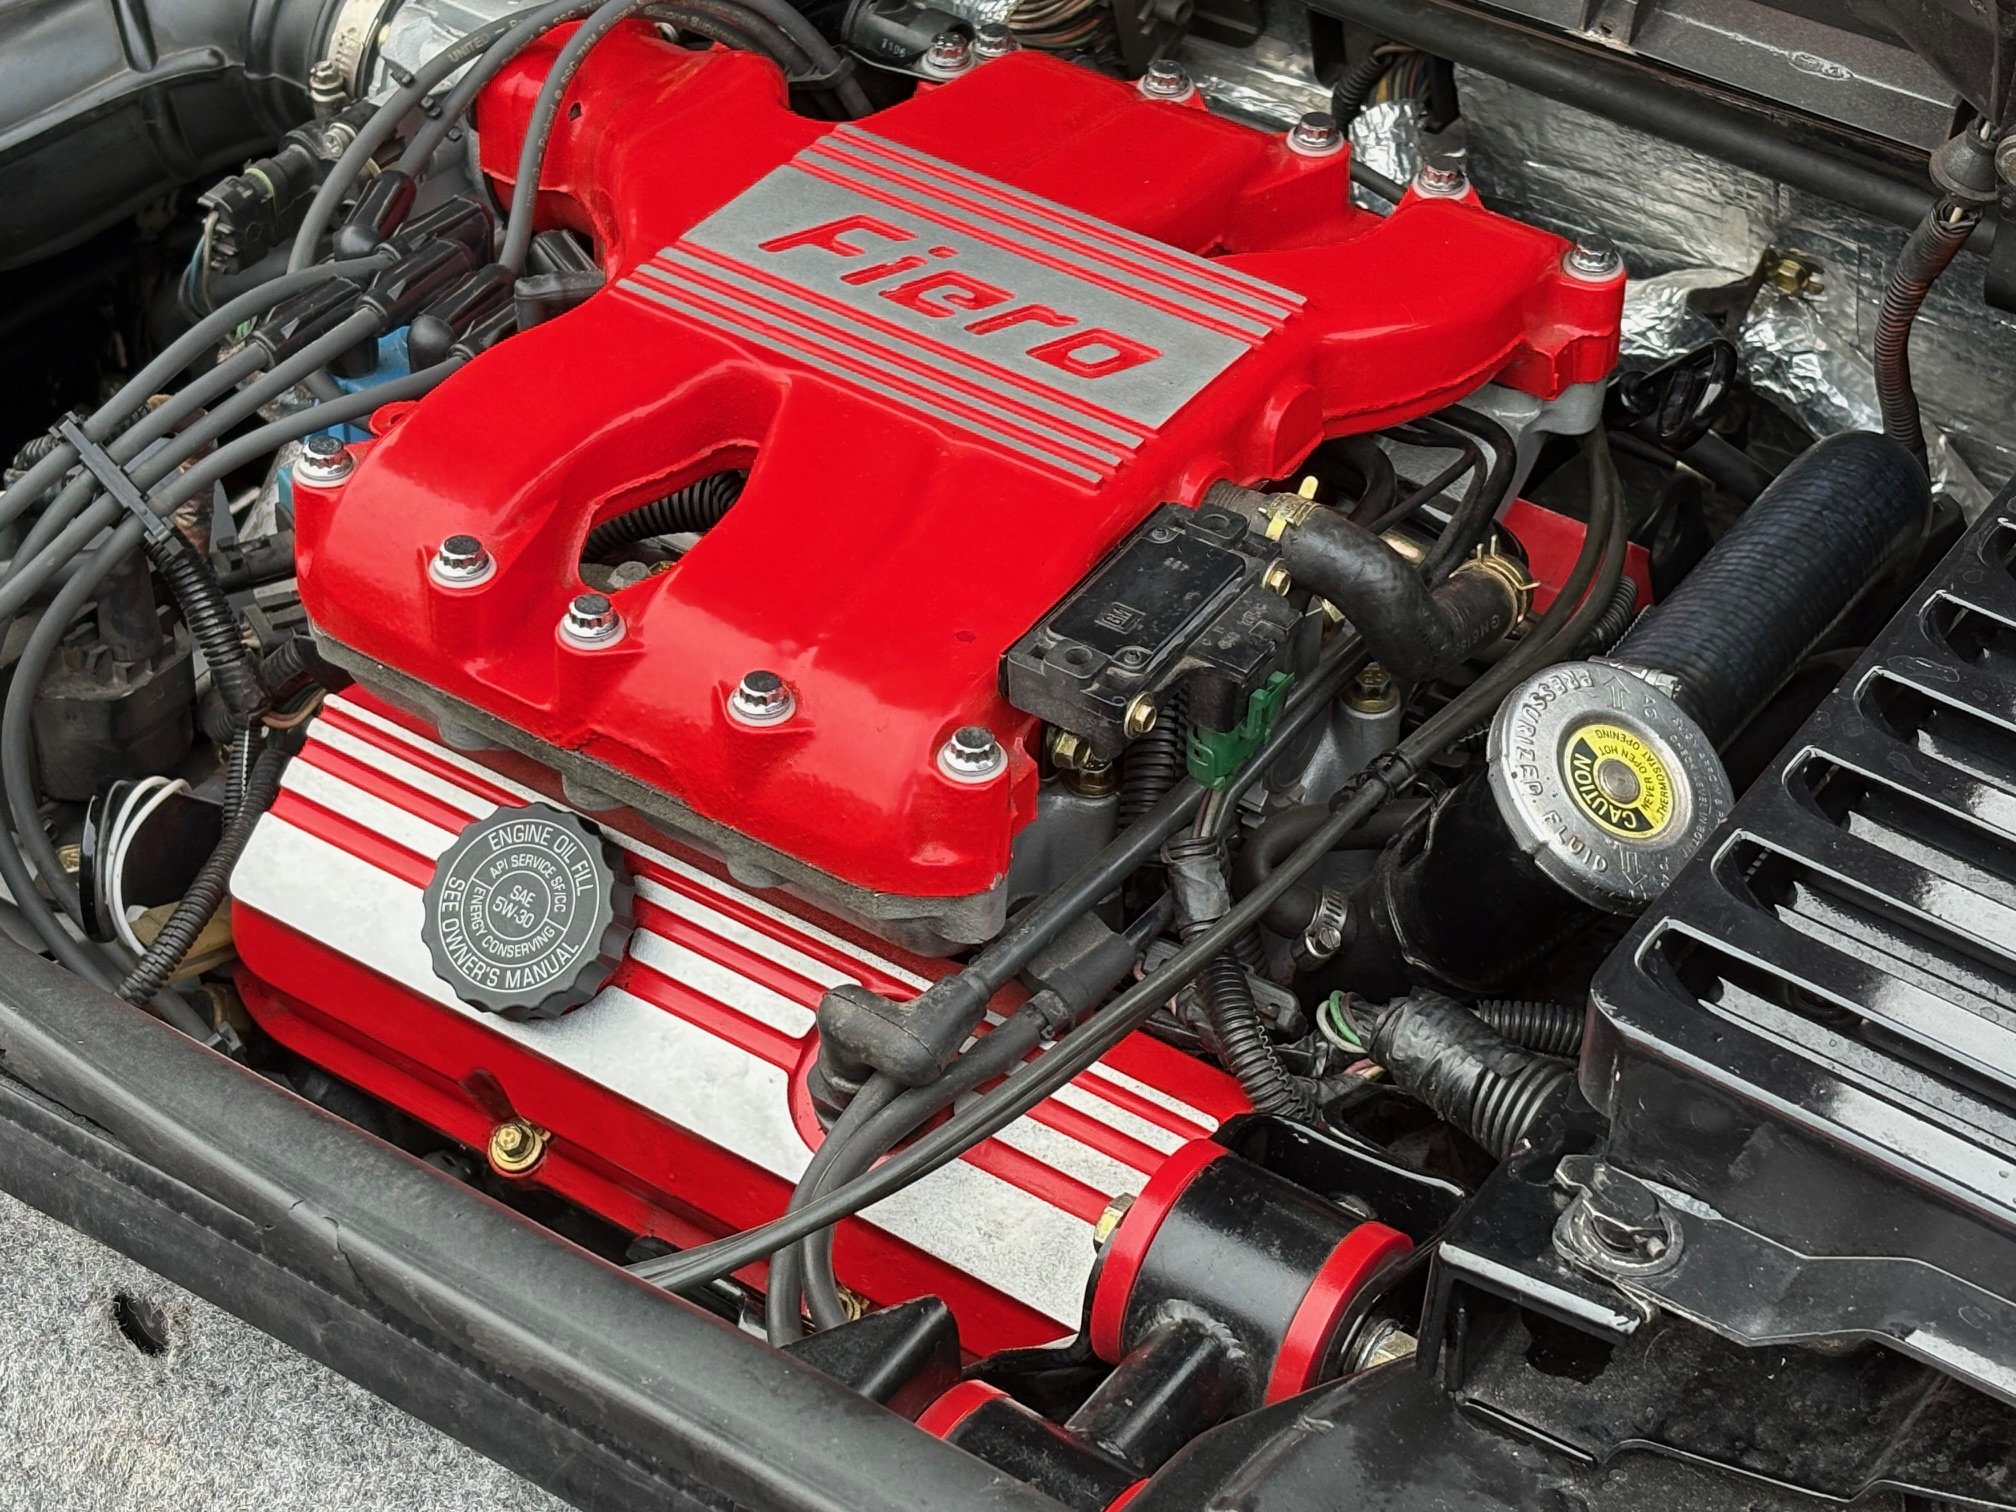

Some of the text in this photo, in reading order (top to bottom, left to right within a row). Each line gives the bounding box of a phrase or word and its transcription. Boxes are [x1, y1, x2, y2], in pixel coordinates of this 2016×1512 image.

[448, 32, 490, 62] UNITED
[758, 214, 1164, 379] Fiero
[1516, 669, 1609, 874] PRESSURIZED FLUID
[1572, 753, 1637, 829] CAUTION
[1596, 729, 1668, 822] THERMOSTAT OPENING
[1598, 745, 1656, 812] NEVER OPEN HOT
[488, 824, 594, 897] ENGINE OIL FILL
[489, 853, 567, 913] API SERVICE SF/CC
[509, 885, 536, 908] SAE
[442, 876, 579, 989] SEE OWNER'S MANUAL
[469, 886, 555, 958] ENERGY CONSERVING
[492, 896, 535, 929] 5W-30
